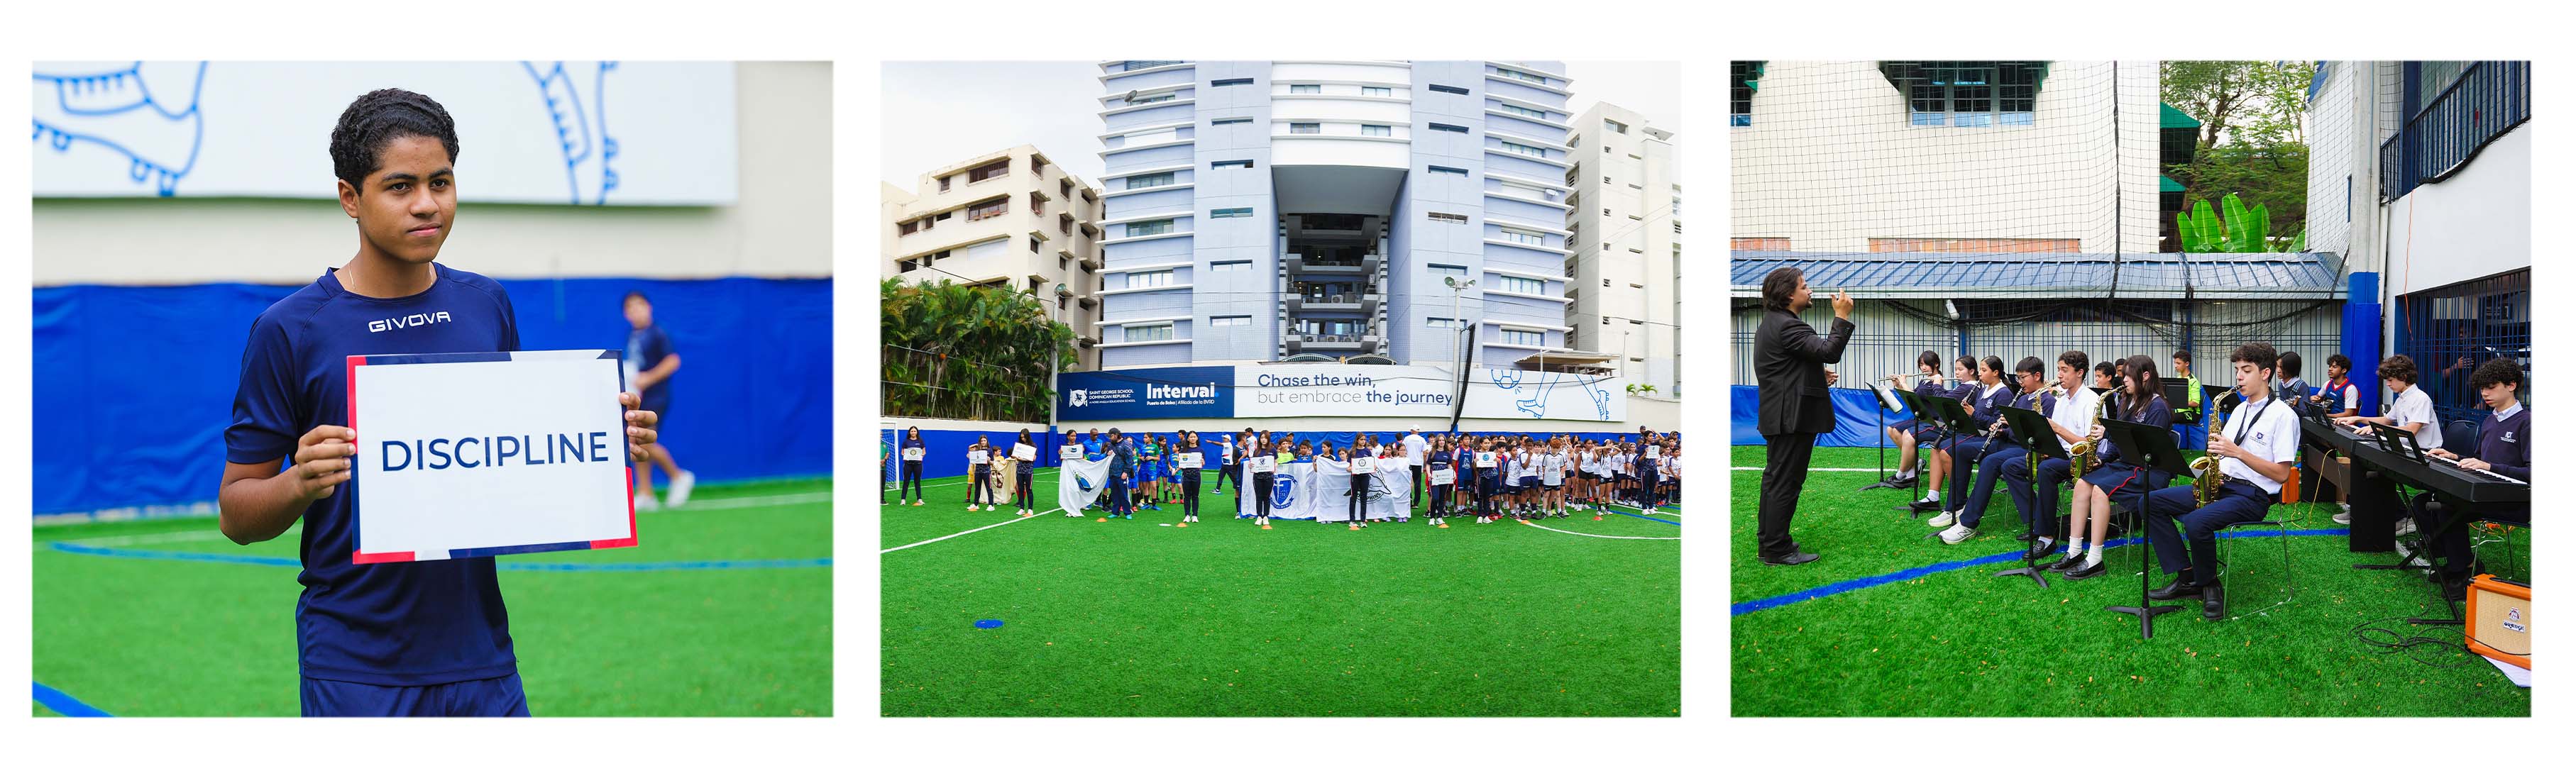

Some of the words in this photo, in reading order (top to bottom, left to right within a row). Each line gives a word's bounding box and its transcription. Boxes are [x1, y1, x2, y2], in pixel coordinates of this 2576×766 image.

[368, 311, 451, 333] GIVOVA
[1257, 374, 1309, 387] Chase
[1314, 374, 1340, 387] the
[1345, 373, 1376, 388] win,
[1257, 390, 1284, 404] but
[1289, 389, 1362, 403] embrace
[1366, 390, 1392, 403] the
[1395, 390, 1453, 406] journey
[382, 431, 609, 472] DISCIPLINE
